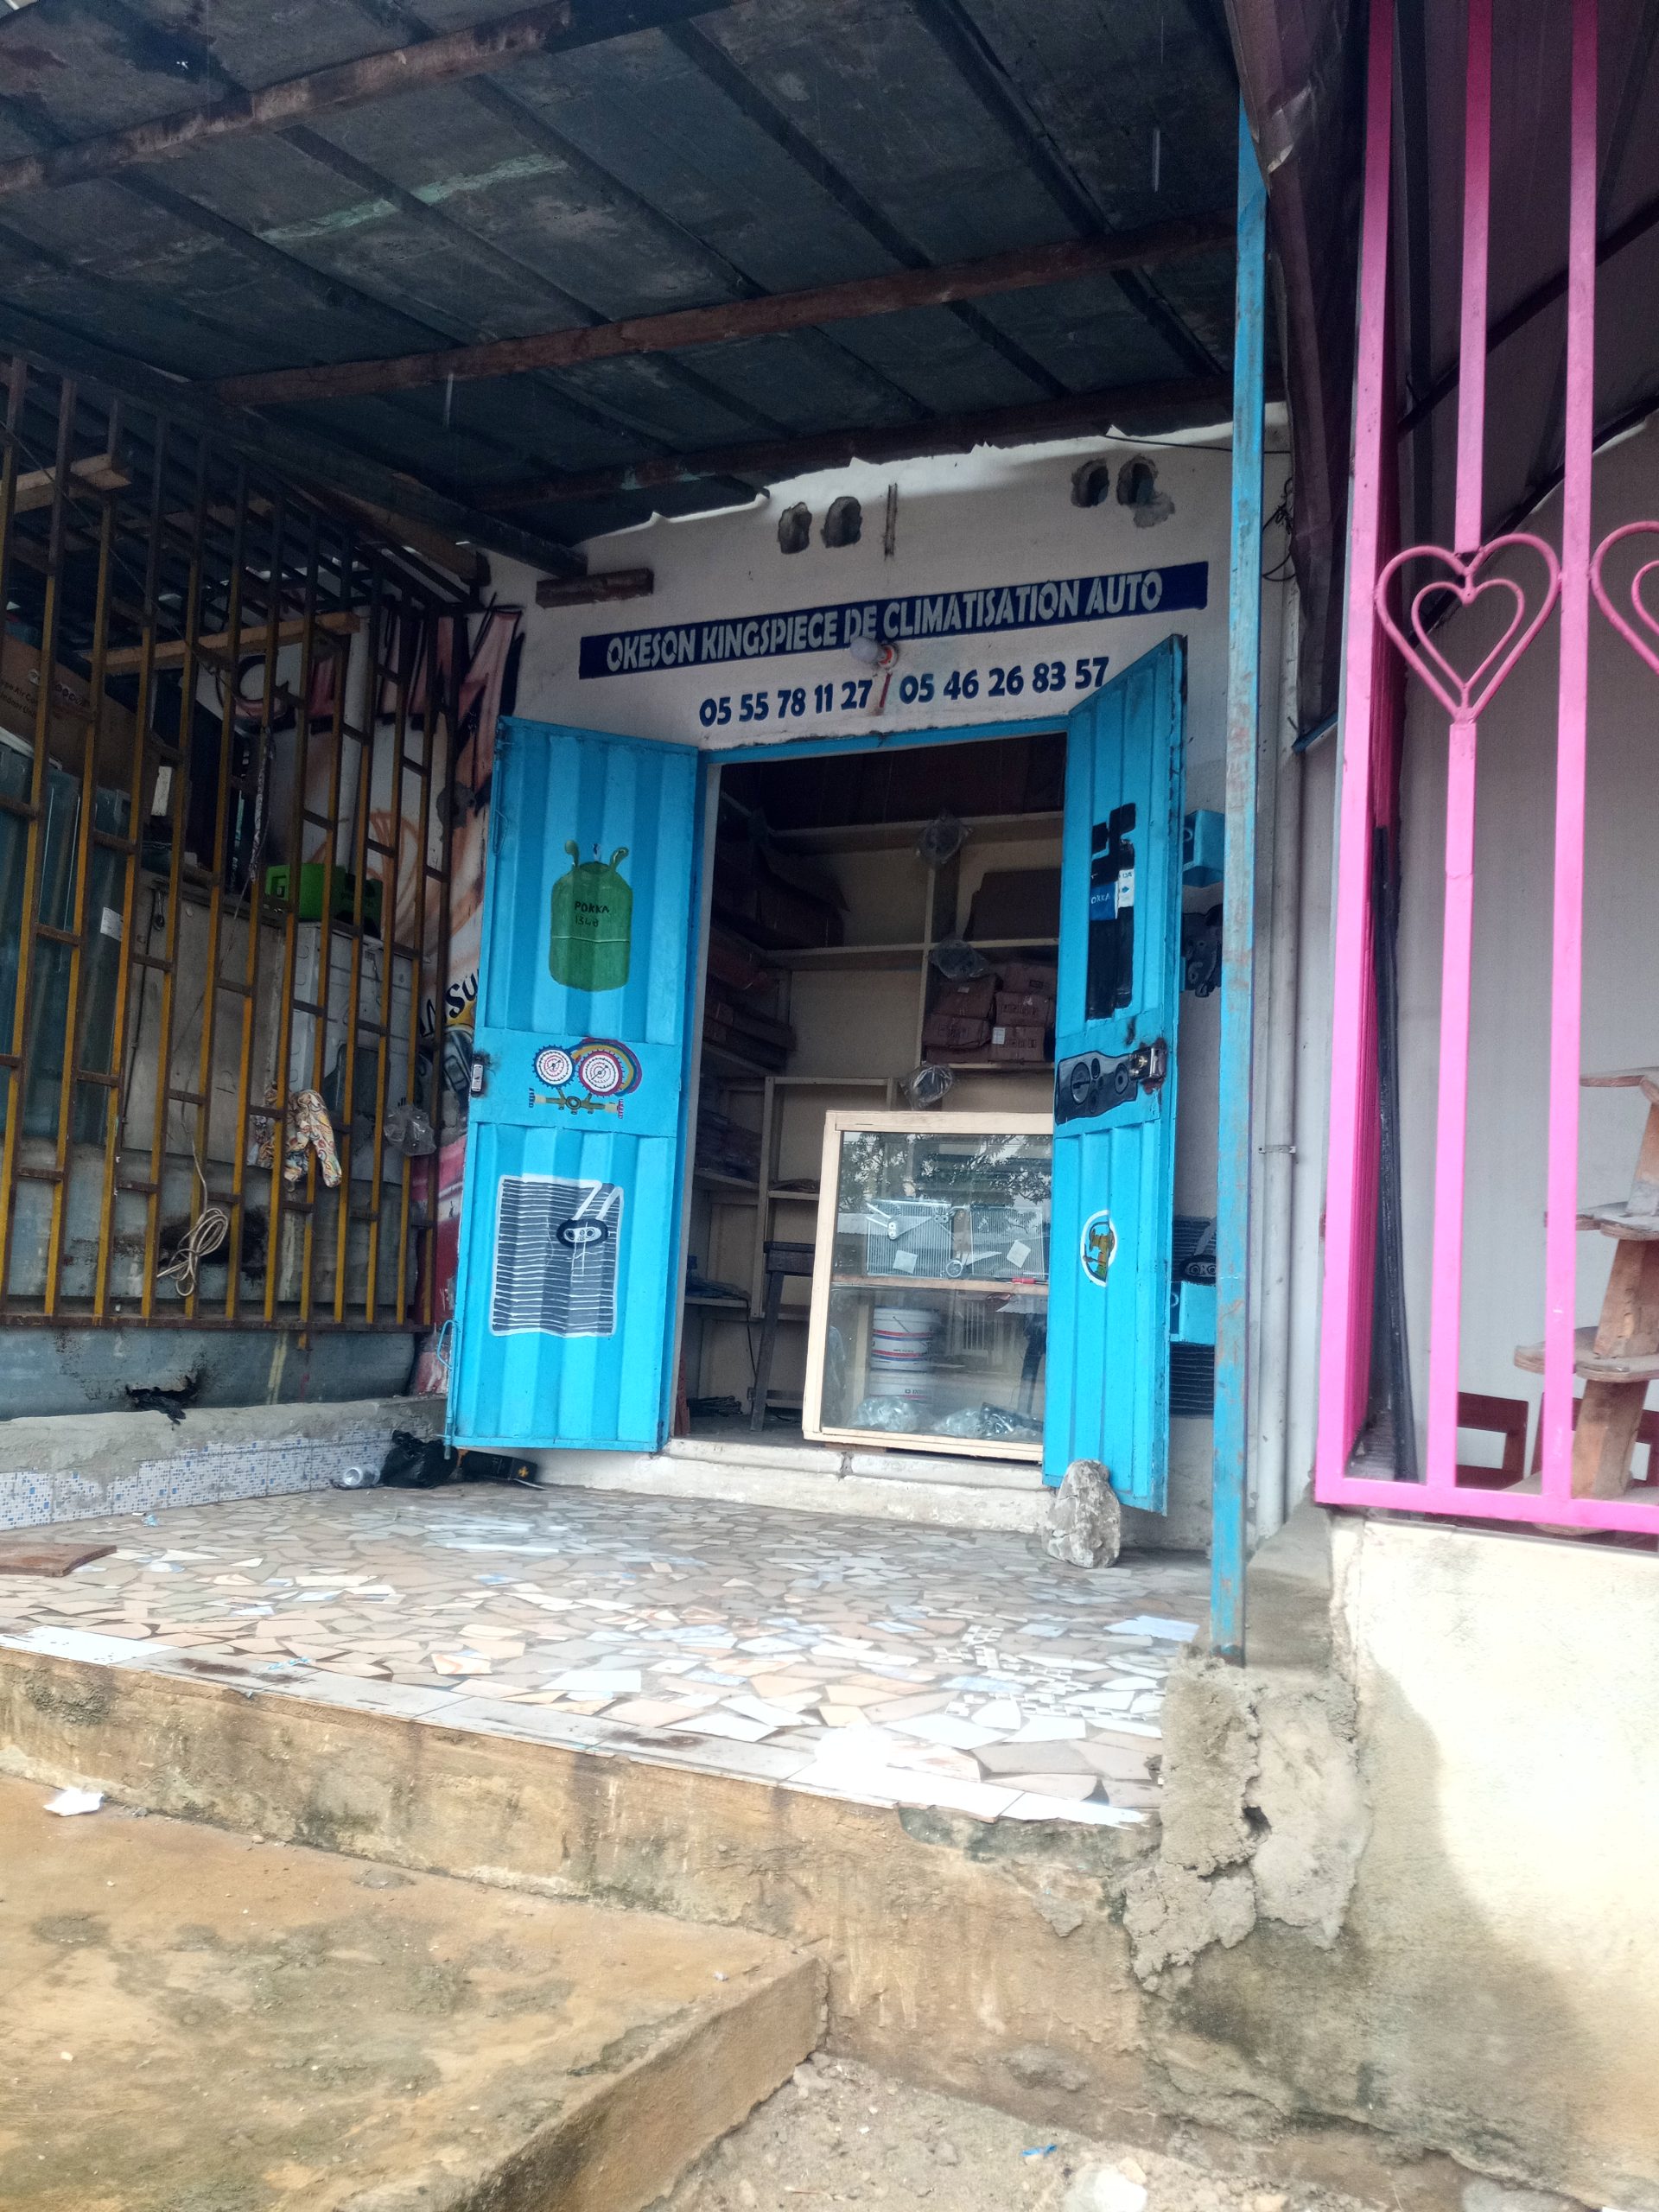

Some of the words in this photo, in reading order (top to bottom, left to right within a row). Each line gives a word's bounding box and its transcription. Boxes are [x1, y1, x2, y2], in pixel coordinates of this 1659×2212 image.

[607, 627, 696, 672] OKESON
[843, 605, 877, 644] DE
[882, 580, 1080, 639] CLIMATISATION
[1085, 570, 1163, 616] AUTO
[698, 696, 732, 728] 05
[738, 691, 769, 723] 55
[778, 687, 806, 719] 78
[814, 683, 834, 714] 11
[840, 679, 873, 710] 27
[899, 673, 935, 705] 05
[943, 669, 979, 701] 46
[988, 665, 1024, 697] 26
[1032, 660, 1067, 693] 83
[1074, 656, 1109, 690] 57
[574, 900, 610, 914] POKKA
